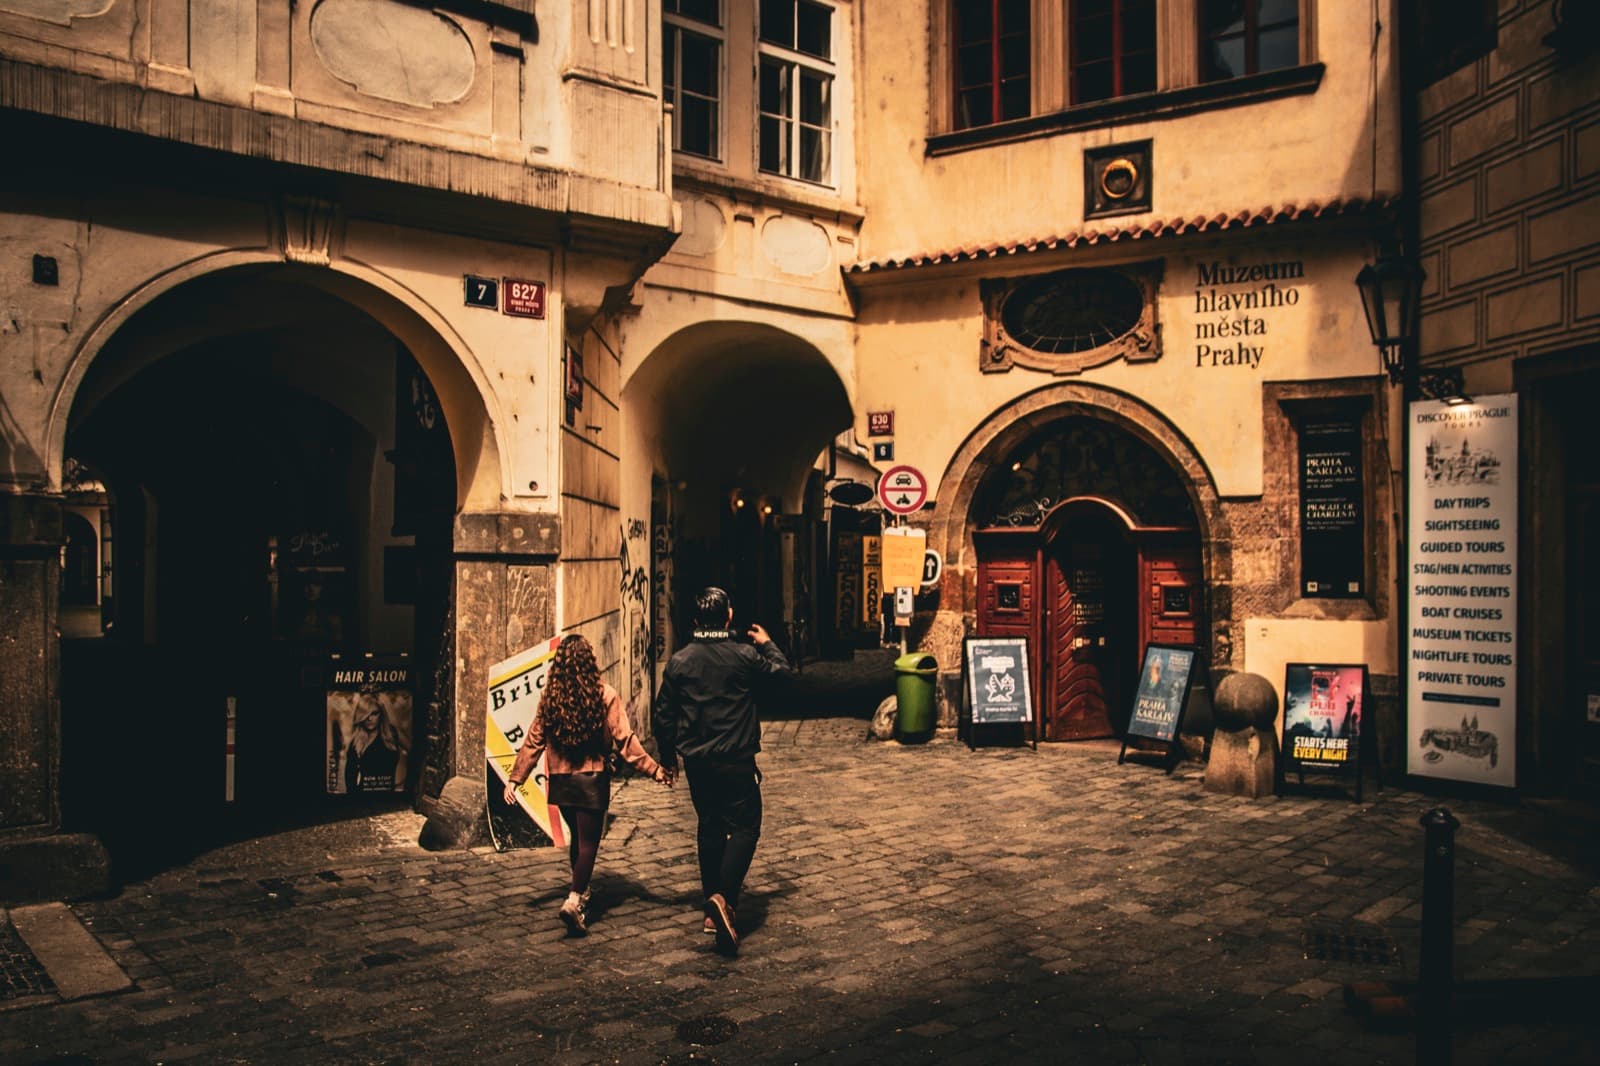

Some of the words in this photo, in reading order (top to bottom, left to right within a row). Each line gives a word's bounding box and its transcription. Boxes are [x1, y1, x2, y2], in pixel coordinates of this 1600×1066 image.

[1195, 260, 1304, 287] Muzeum
[478, 284, 487, 300] 7
[512, 283, 538, 300] 627
[1195, 283, 1300, 313] hlavního
[1195, 315, 1267, 339] města
[1195, 342, 1264, 369] Prahy
[872, 414, 888, 425] 630
[1468, 407, 1510, 420] PRAGUE
[880, 445, 886, 456] 6
[1306, 458, 1342, 467] PRAHA
[1306, 466, 1342, 476] KARLA
[1425, 519, 1500, 531] SIGHTSEEING
[1420, 541, 1462, 553] GUIDED
[1466, 541, 1505, 553] TOURS
[1414, 563, 1459, 576] STAG/HEN
[1461, 564, 1512, 575] ACTIVITIES
[1415, 585, 1468, 597] SHOOTING
[1470, 586, 1510, 598] EVENTS
[1422, 607, 1451, 618] BOAT
[1453, 607, 1503, 620] CRUISES
[1413, 628, 1461, 640] MUSEUM
[1464, 630, 1512, 643] TICKETS
[1413, 649, 1469, 663] NIGHTLIFE
[1473, 653, 1512, 666] TOURS
[336, 671, 364, 683] HAIR
[368, 670, 407, 682] SALON
[1418, 671, 1463, 684] PRIVATE
[1466, 674, 1506, 688] TOURS
[1139, 699, 1166, 711] PRAHA
[1136, 708, 1163, 720] KARLA
[1295, 736, 1326, 748] STARTS
[1326, 738, 1349, 749] HERE
[1294, 747, 1321, 759] EVERY
[1322, 749, 1348, 761] NIGHT
